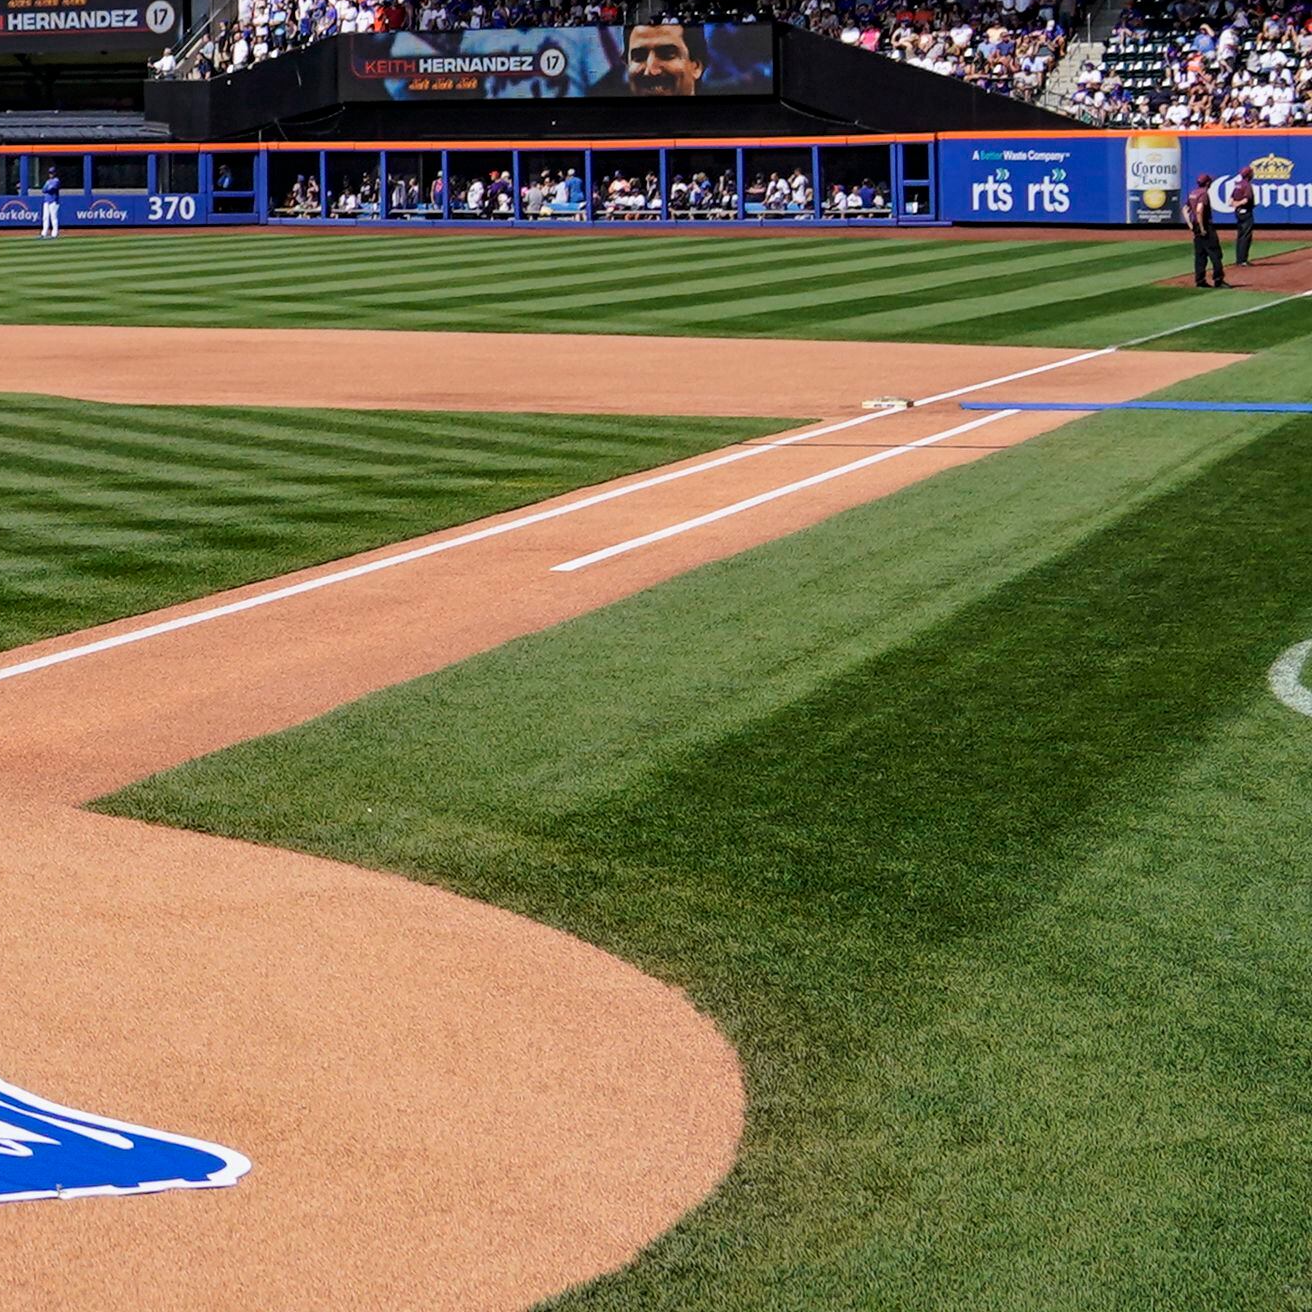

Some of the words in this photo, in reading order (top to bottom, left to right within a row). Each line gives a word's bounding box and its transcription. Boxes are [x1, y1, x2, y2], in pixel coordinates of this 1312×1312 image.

[7, 9, 138, 31] HERNANDEZ
[152, 8, 167, 26] 17
[365, 59, 416, 74] KEITH
[418, 55, 534, 74] HERNANDEZ
[545, 55, 560, 71] 17
[972, 175, 1013, 212] rts
[1028, 175, 1070, 213] rts
[76, 208, 127, 221] workday
[147, 197, 196, 221] 370
